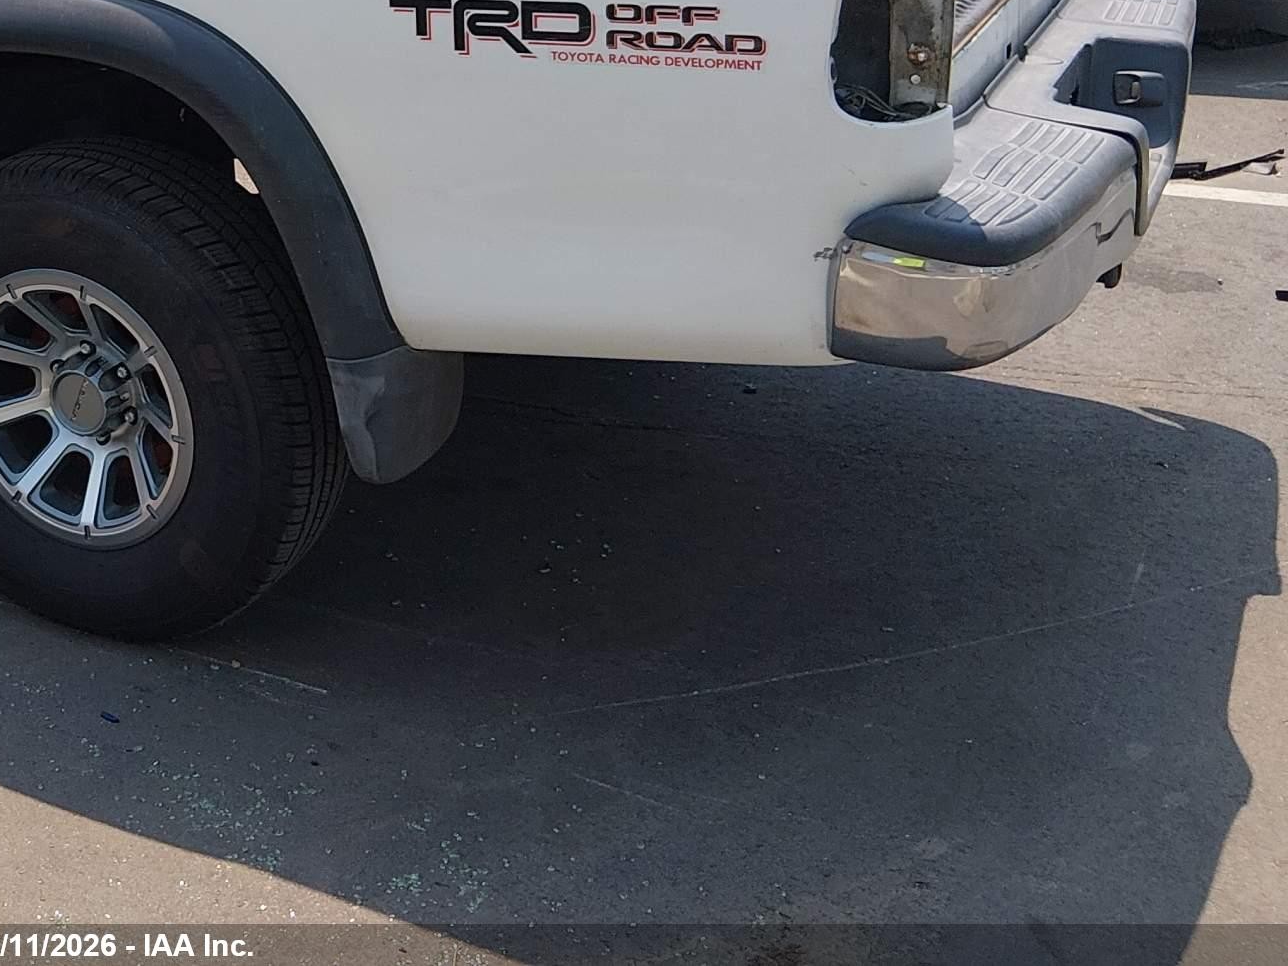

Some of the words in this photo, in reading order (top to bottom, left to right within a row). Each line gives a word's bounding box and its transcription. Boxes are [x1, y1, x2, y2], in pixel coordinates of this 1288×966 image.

[605, 3, 720, 26] OFF
[605, 29, 766, 55] ROAD
[551, 51, 605, 63] TOYOTA
[608, 54, 661, 66] RACING
[664, 56, 763, 71] DEVELOPMENT
